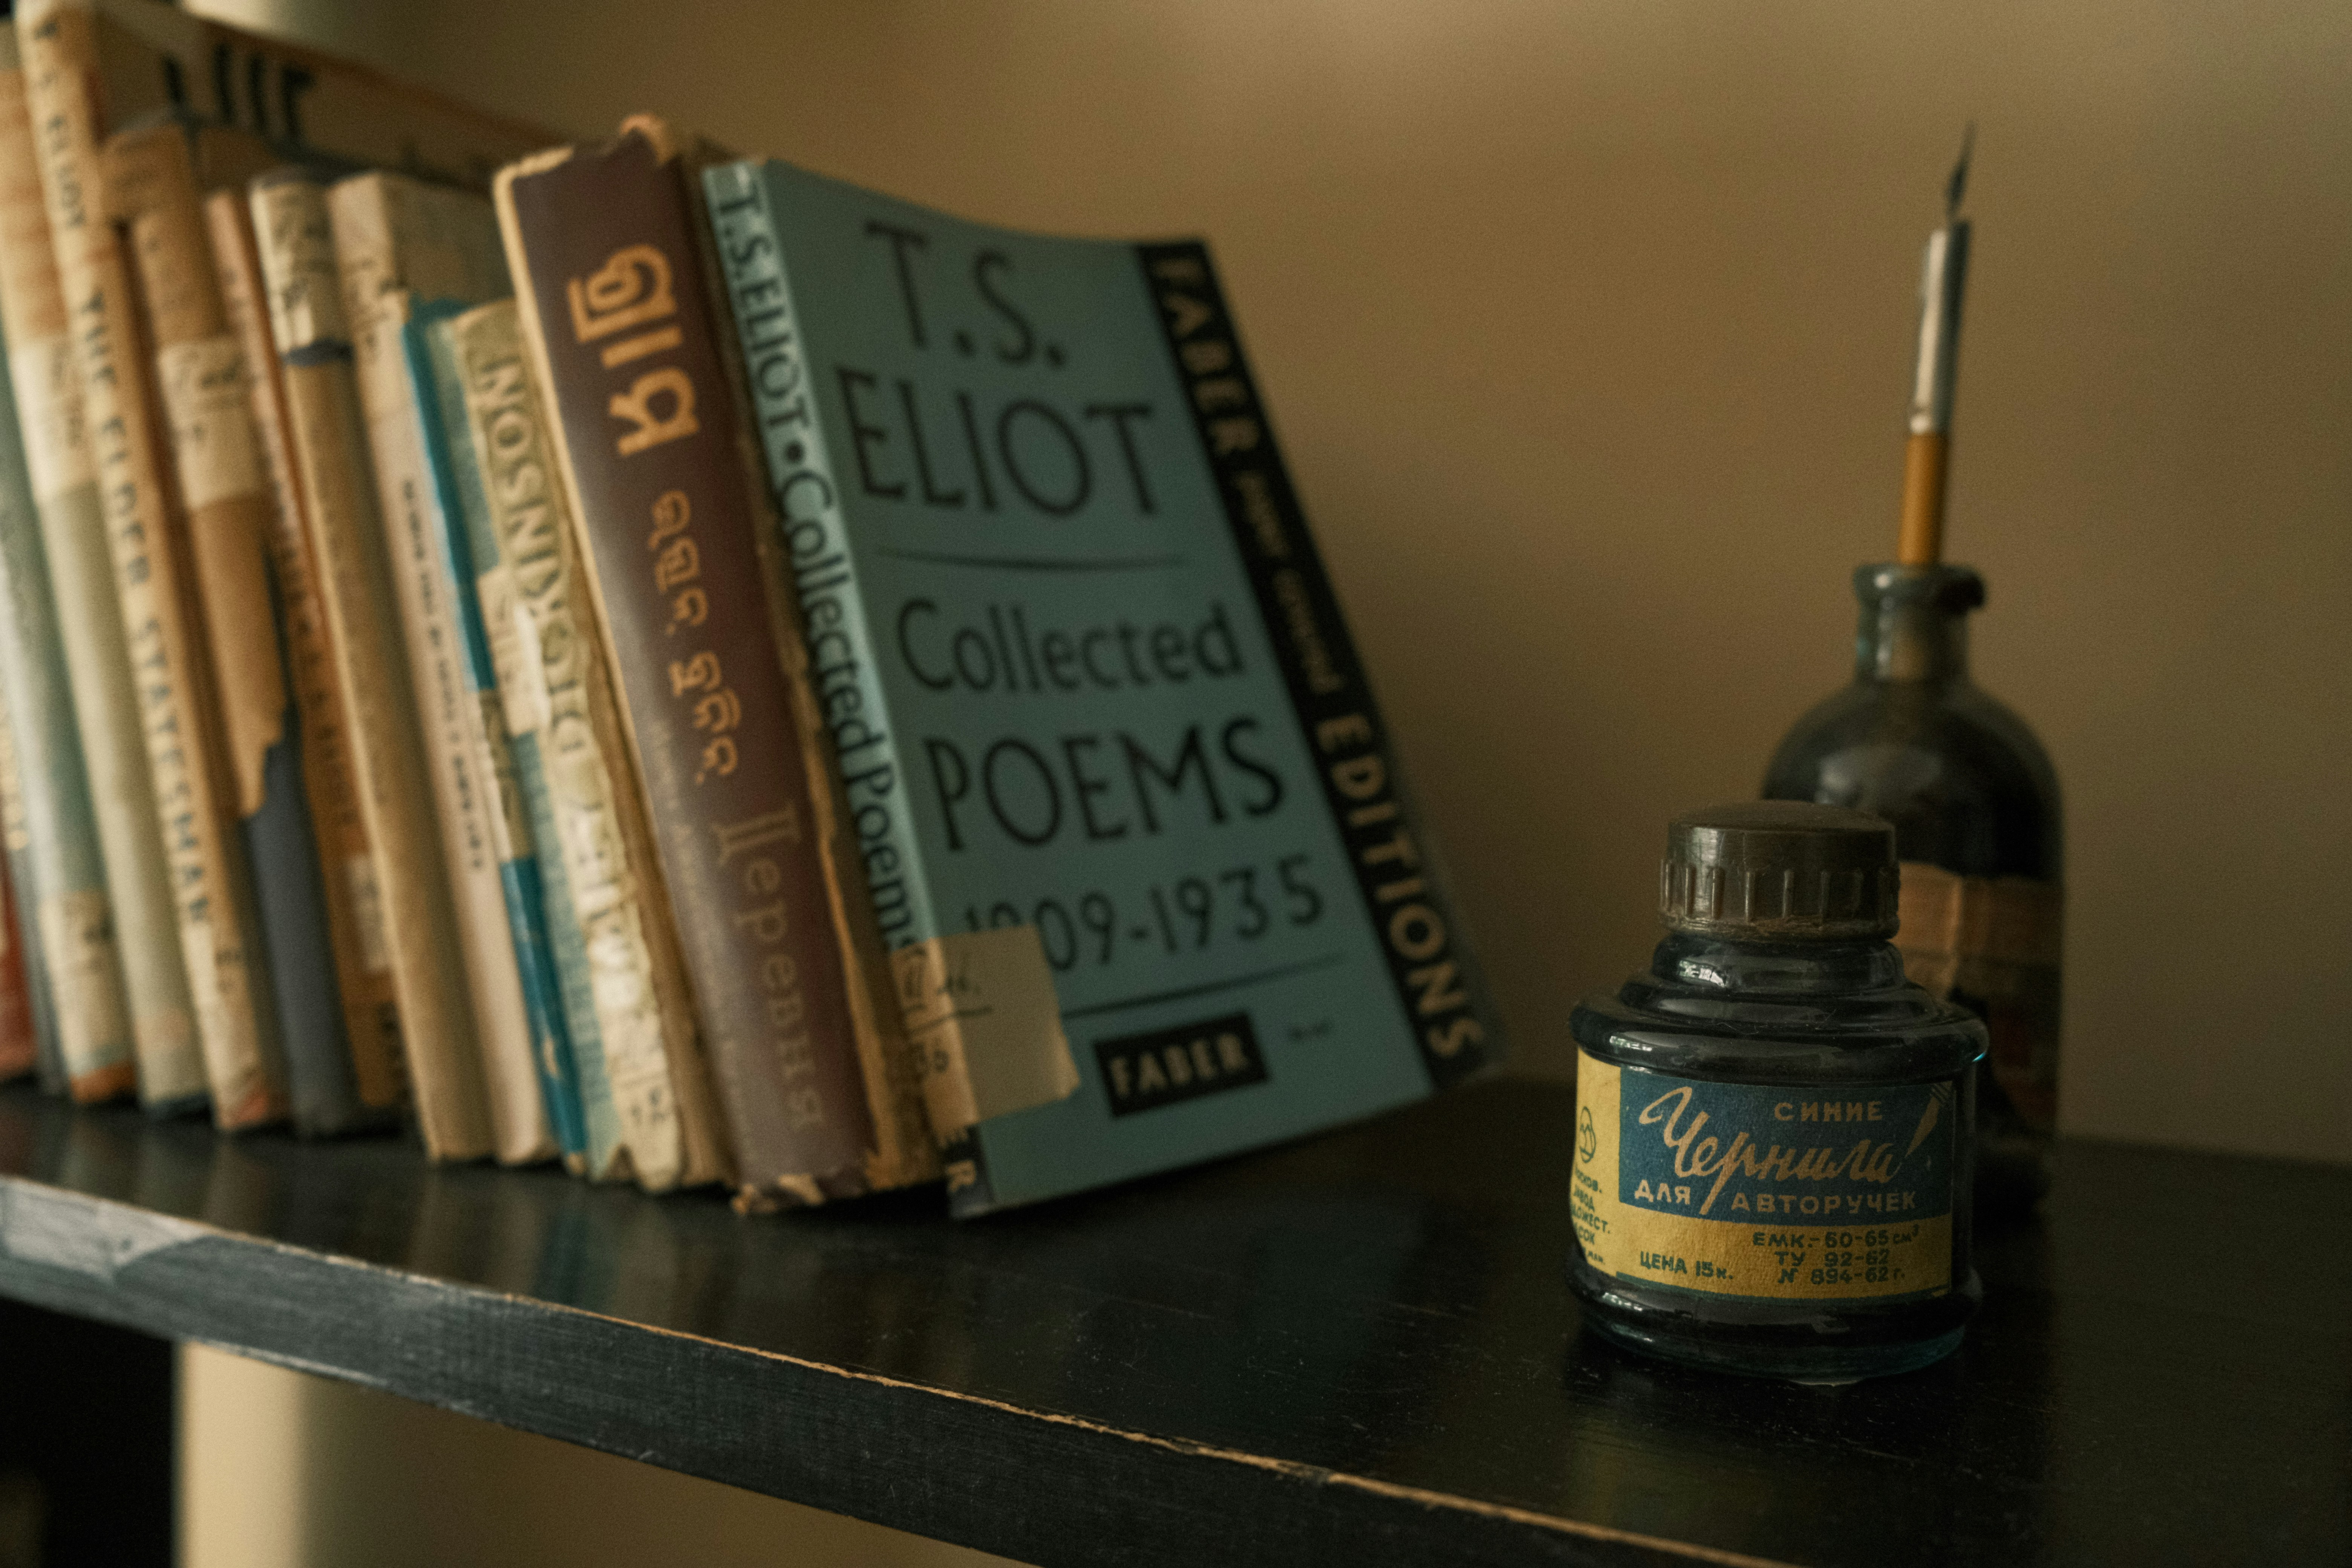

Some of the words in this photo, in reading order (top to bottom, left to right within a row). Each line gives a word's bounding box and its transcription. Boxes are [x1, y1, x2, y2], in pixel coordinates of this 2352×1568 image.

[835, 366, 1157, 516] ELIOT
[896, 597, 1245, 694] Collected
[923, 715, 1284, 852] POEMS
[1314, 710, 1485, 1060] EDITIONS
[709, 800, 824, 1133] Деревня
[1107, 1030, 1249, 1101] FABER
[1773, 1100, 1883, 1122] СИНИЕ
[1634, 1179, 1691, 1205] ДЛЯ
[1731, 1191, 1916, 1214] АВТОРУЧЕК
[1638, 1086, 1900, 1215] Чернила
[1640, 1251, 1687, 1274] ЦЕНА
[1774, 1251, 1806, 1267] ТУ
[1824, 1248, 1890, 1267] 92-62
